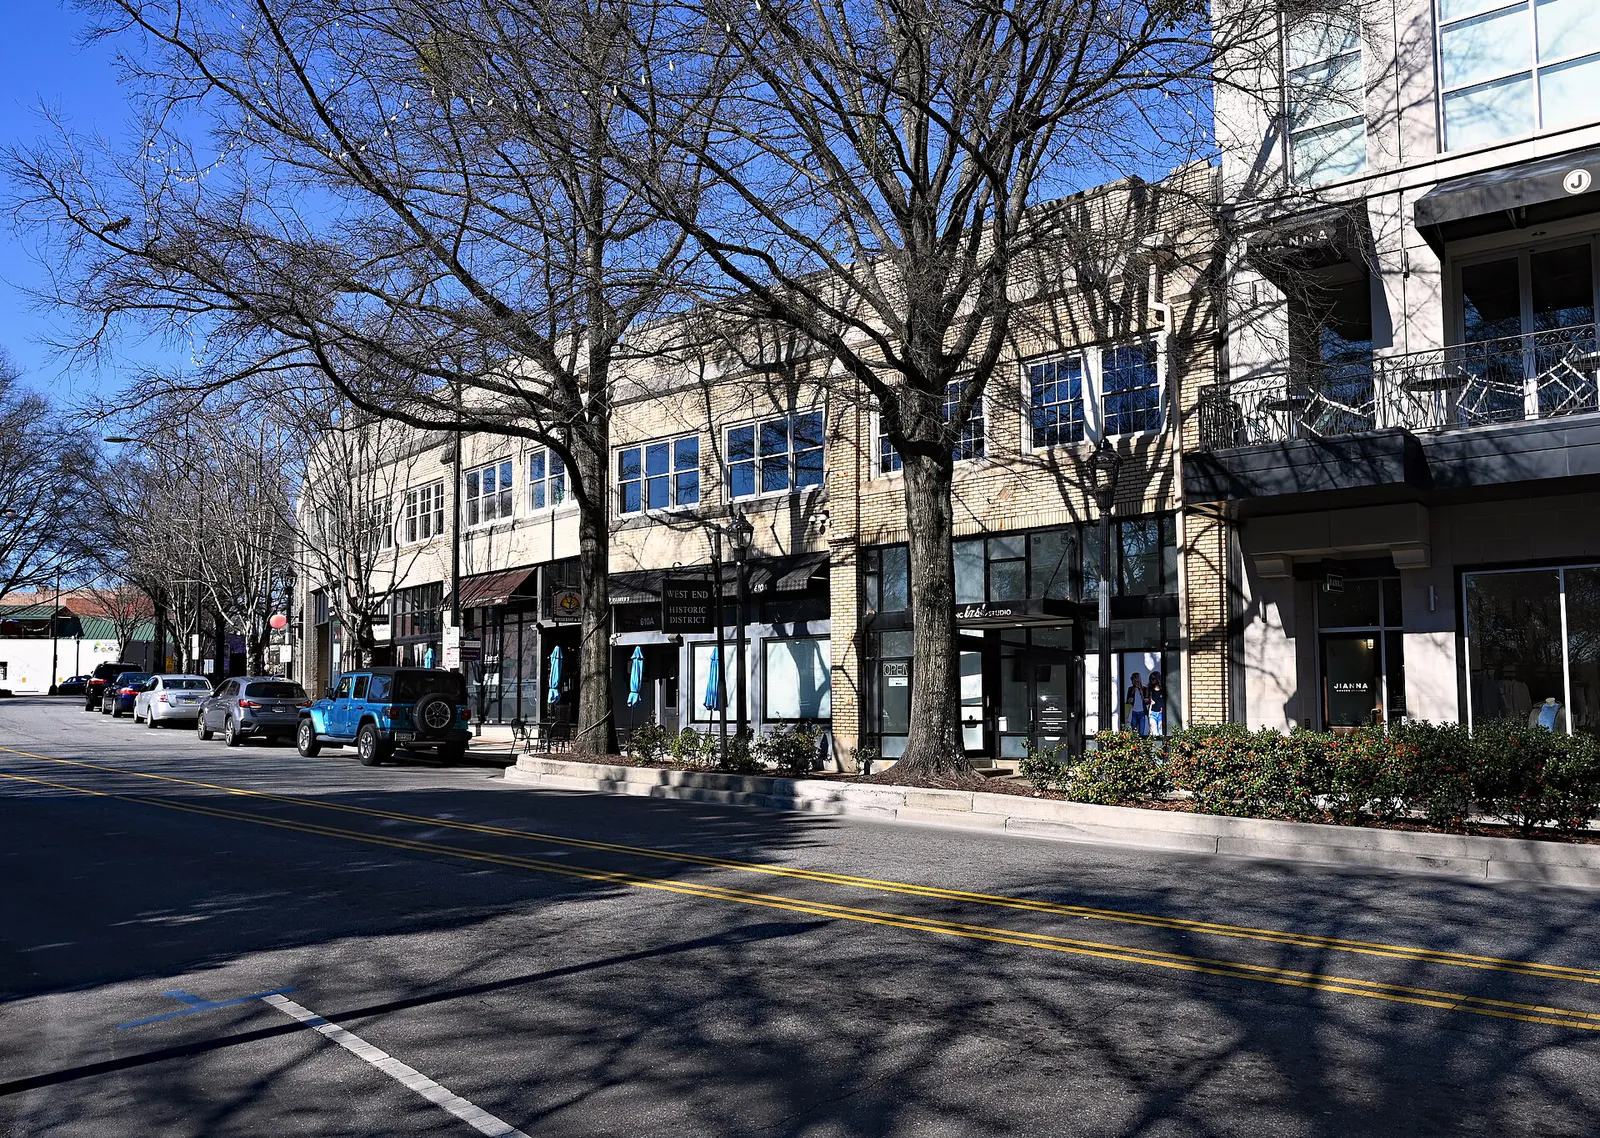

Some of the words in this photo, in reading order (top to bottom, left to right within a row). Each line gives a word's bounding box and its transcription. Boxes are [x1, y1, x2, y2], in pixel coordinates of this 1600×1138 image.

[1570, 174, 1582, 189] J
[666, 590, 689, 599] WEST
[691, 590, 709, 599] END
[669, 606, 707, 614] HISTORIC
[988, 608, 1012, 617] STUDIO
[639, 617, 655, 626] 610A
[669, 616, 707, 624] DISTRICT
[883, 663, 908, 676] OPEN
[1333, 682, 1369, 690] JIANNA
